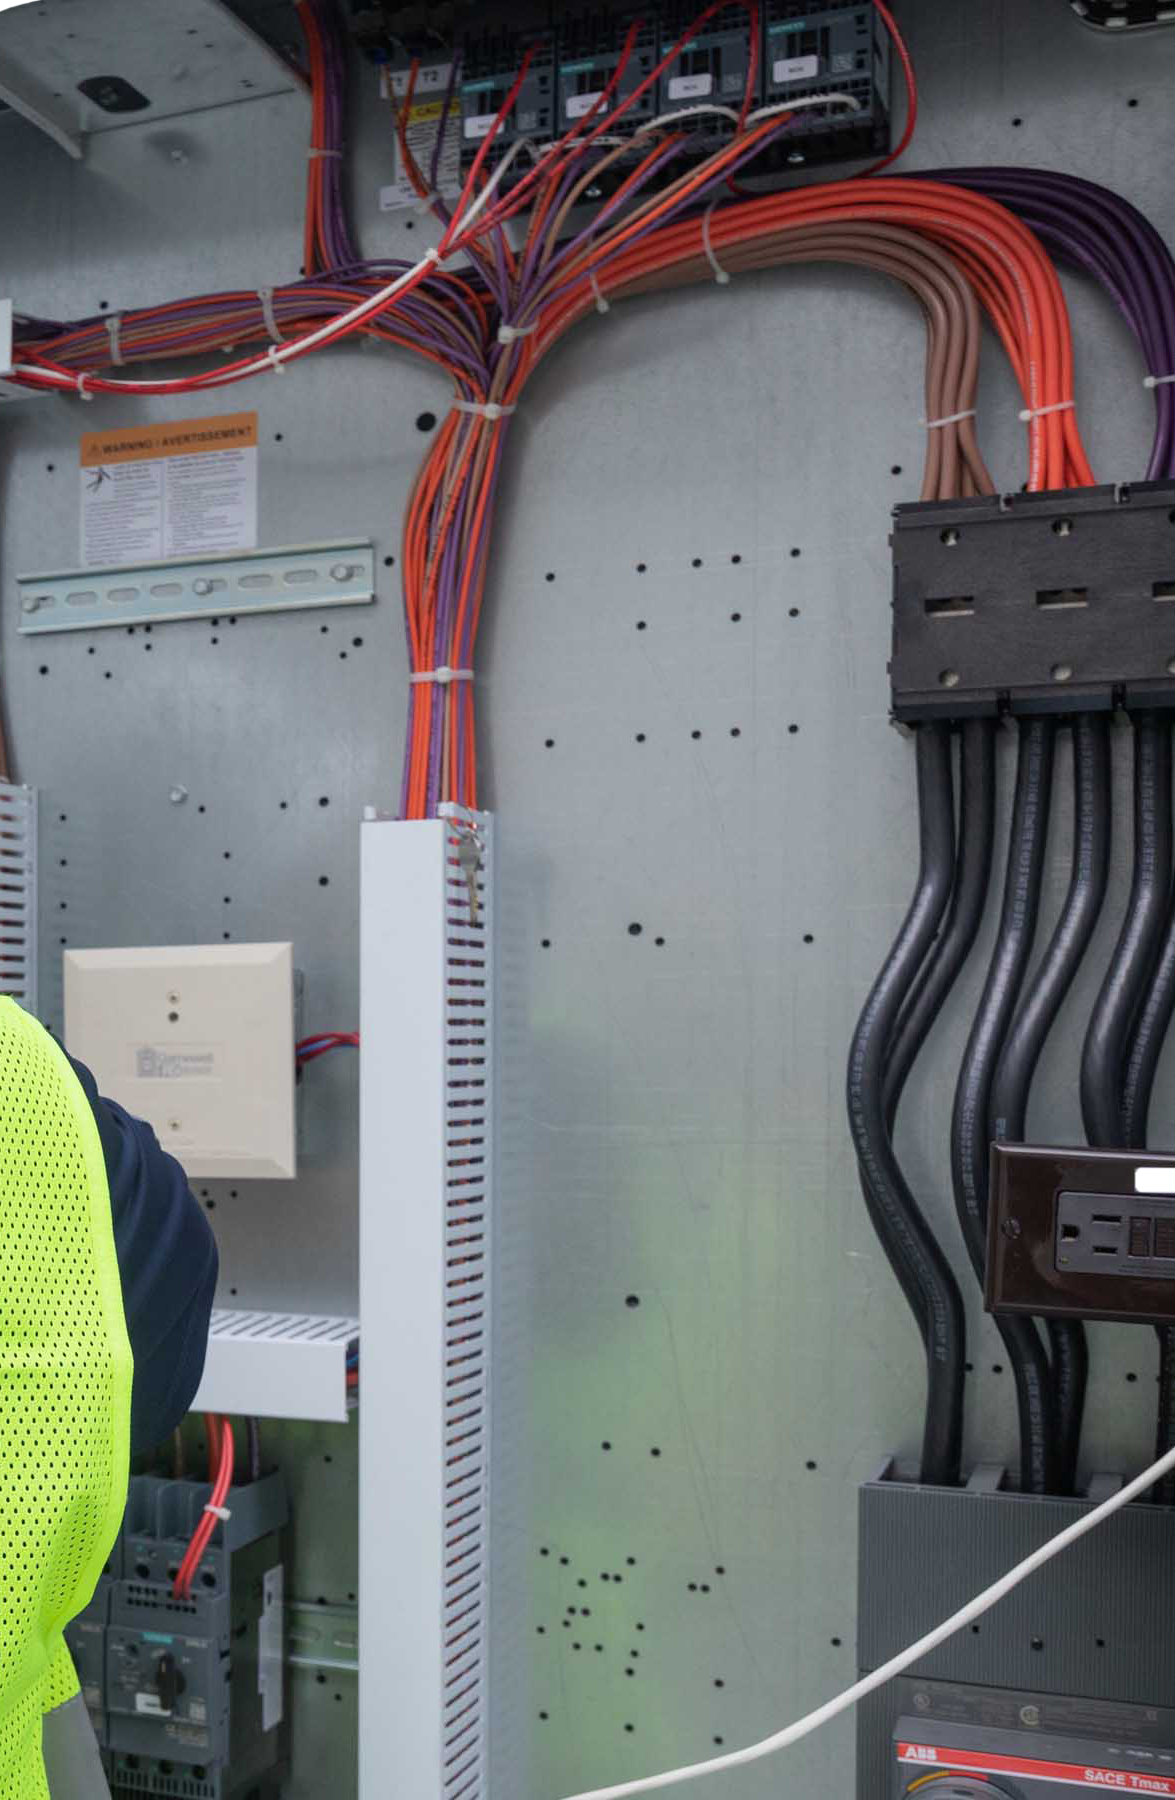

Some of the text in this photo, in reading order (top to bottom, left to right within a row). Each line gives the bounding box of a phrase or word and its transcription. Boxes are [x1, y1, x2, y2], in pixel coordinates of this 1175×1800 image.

[103, 440, 152, 454] WARNING
[162, 426, 252, 446] AVERTISSEMENT
[905, 1746, 937, 1760] ABB
[1084, 1769, 1171, 1792] SACE Tmax
